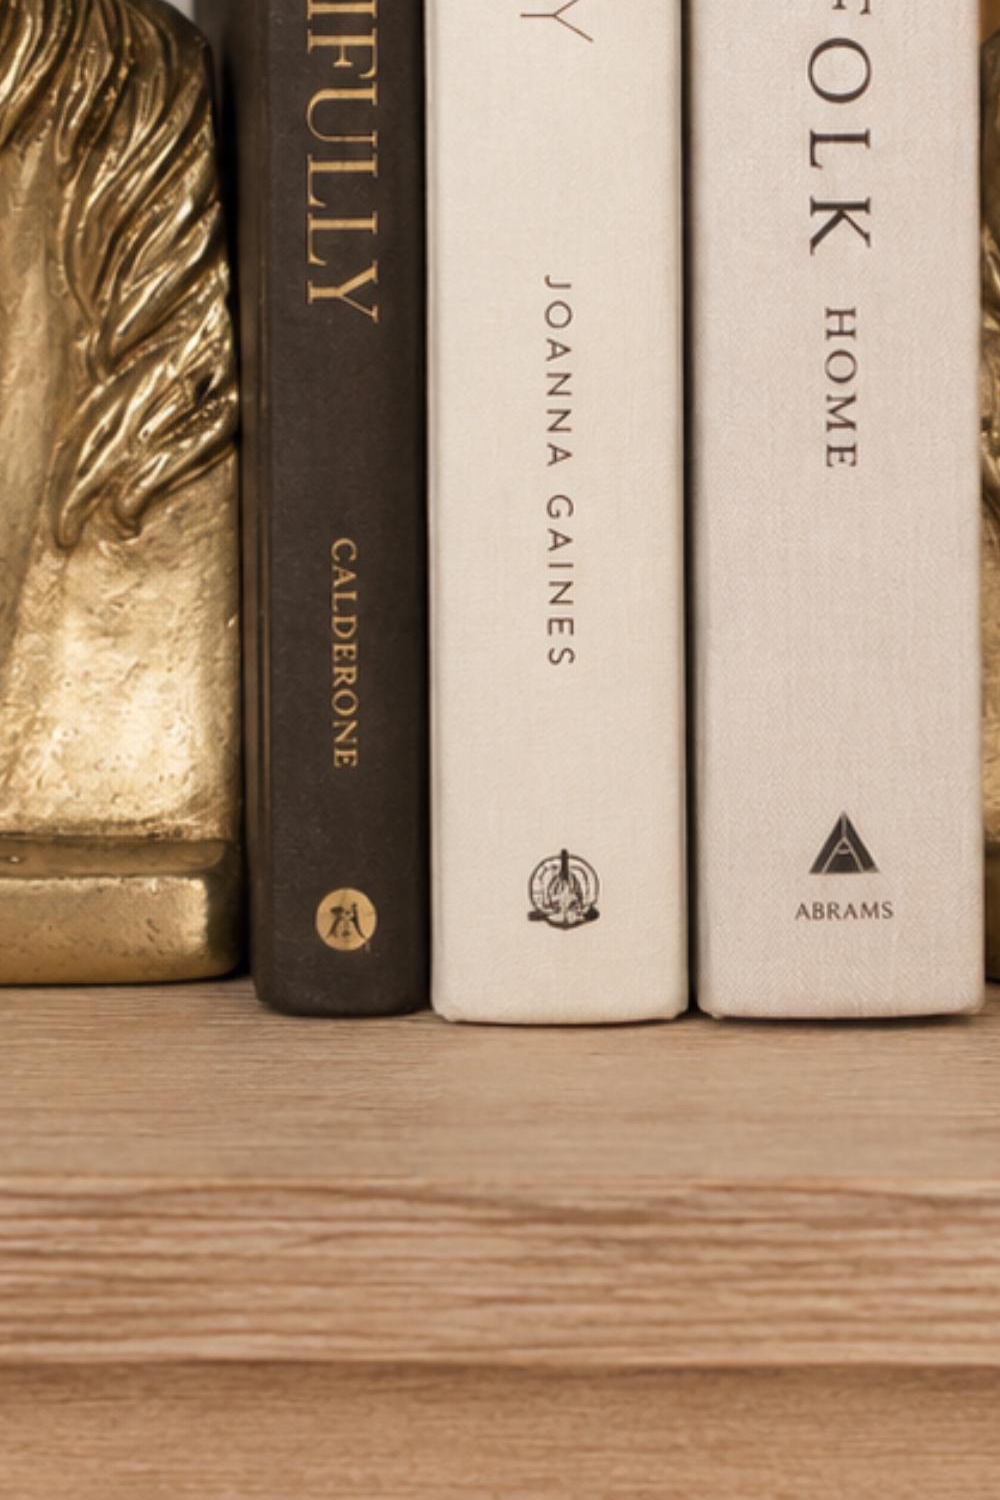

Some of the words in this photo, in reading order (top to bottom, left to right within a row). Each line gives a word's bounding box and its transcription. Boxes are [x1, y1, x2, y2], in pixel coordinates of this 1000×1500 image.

[543, 274, 575, 468] JOANNA
[824, 307, 858, 469] HOME
[329, 537, 360, 769] CALDERONE
[545, 493, 576, 667] GAINES
[794, 900, 895, 922] ABRAMS
